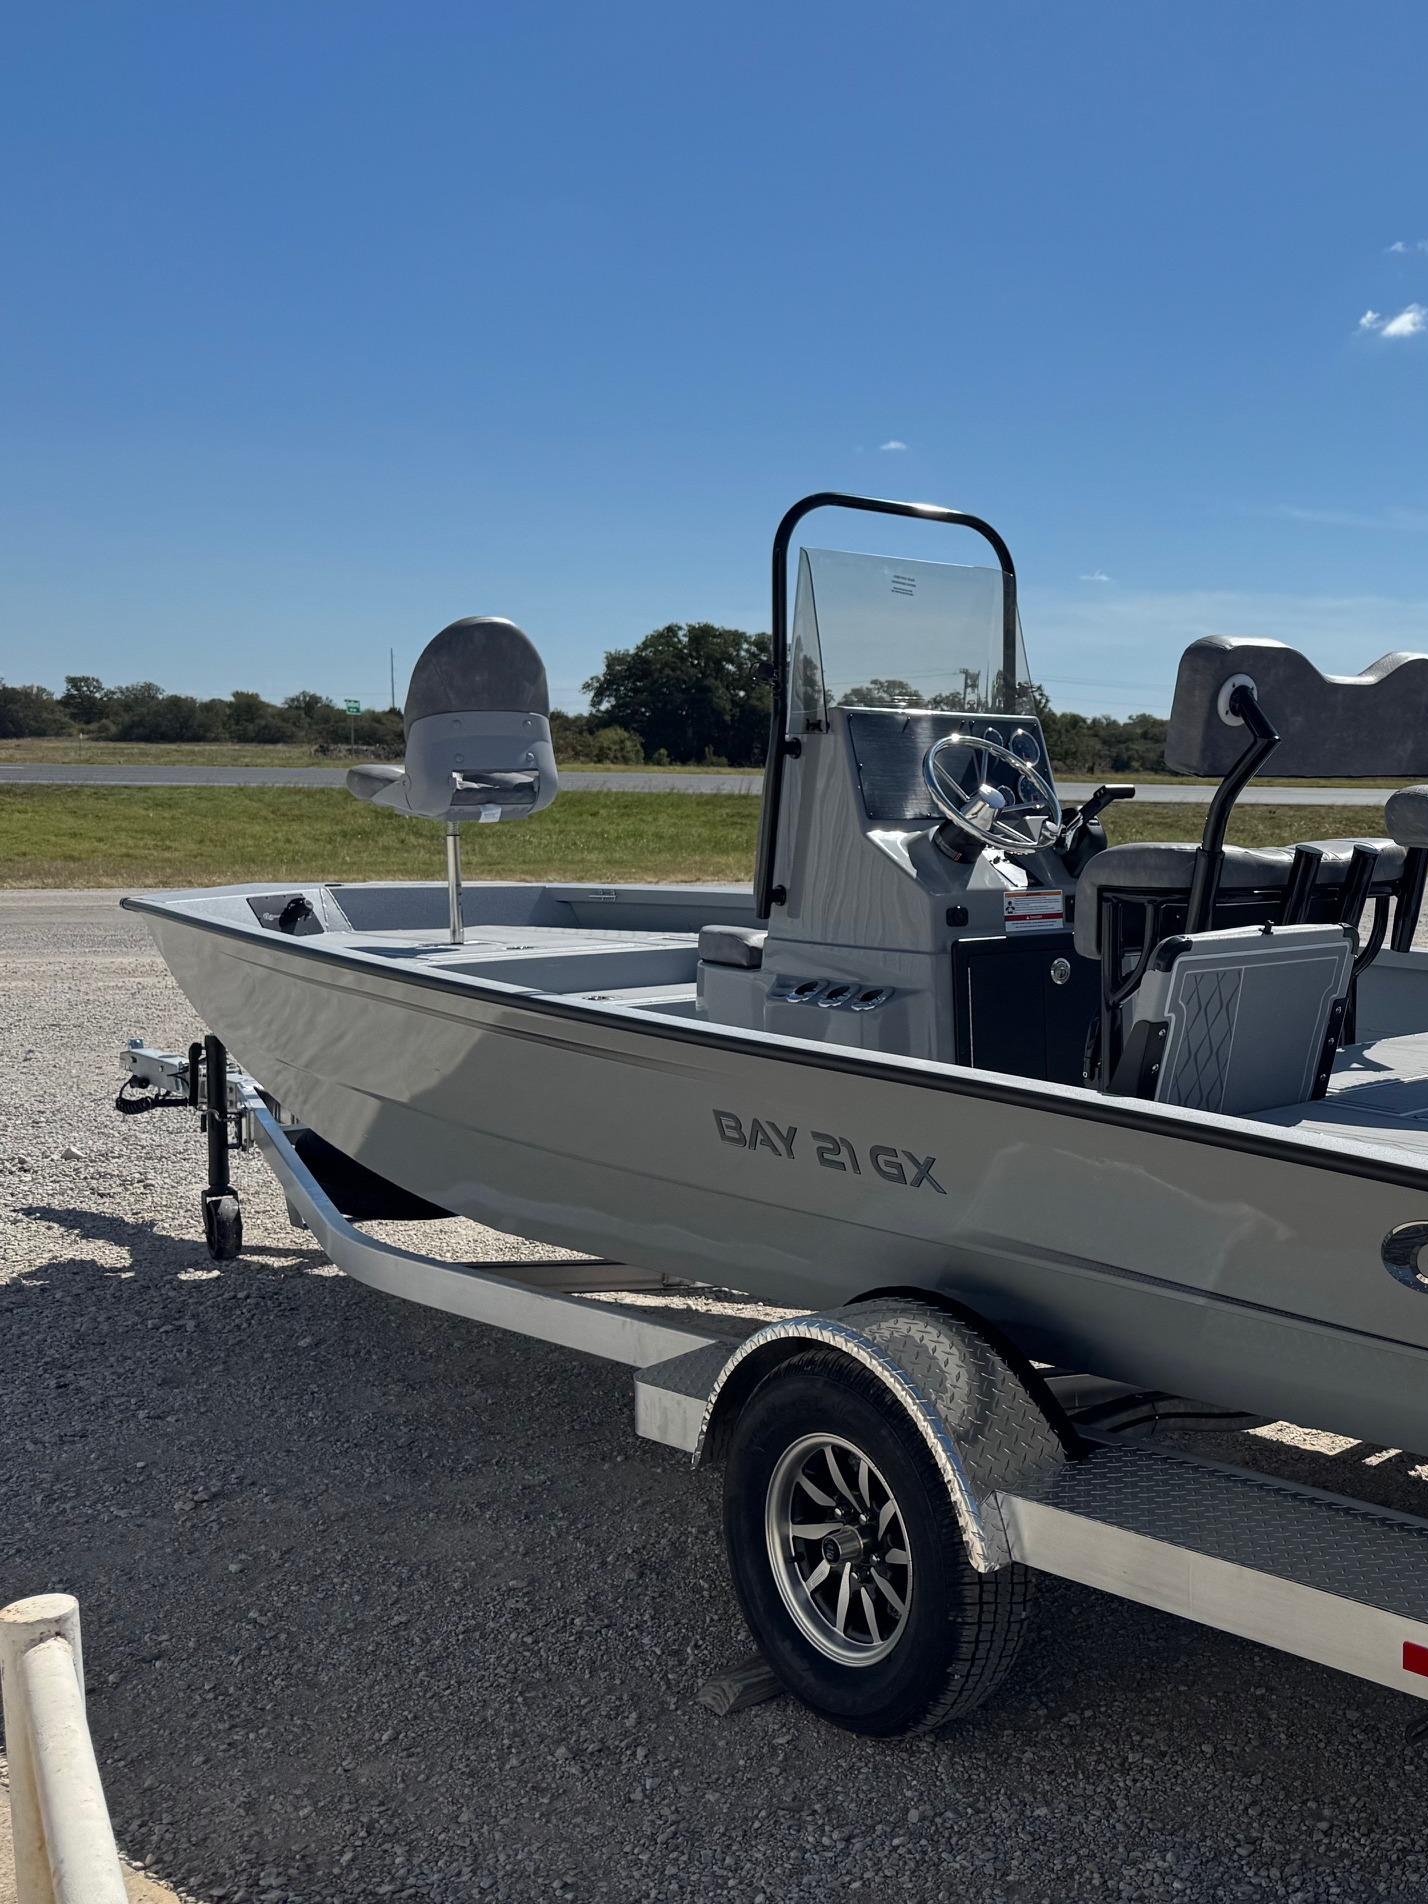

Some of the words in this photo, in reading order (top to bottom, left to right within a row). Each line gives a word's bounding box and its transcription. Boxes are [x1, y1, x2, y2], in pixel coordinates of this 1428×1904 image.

[713, 1109, 797, 1159] BAY
[810, 1131, 861, 1175] 21
[870, 1145, 947, 1195] GX
